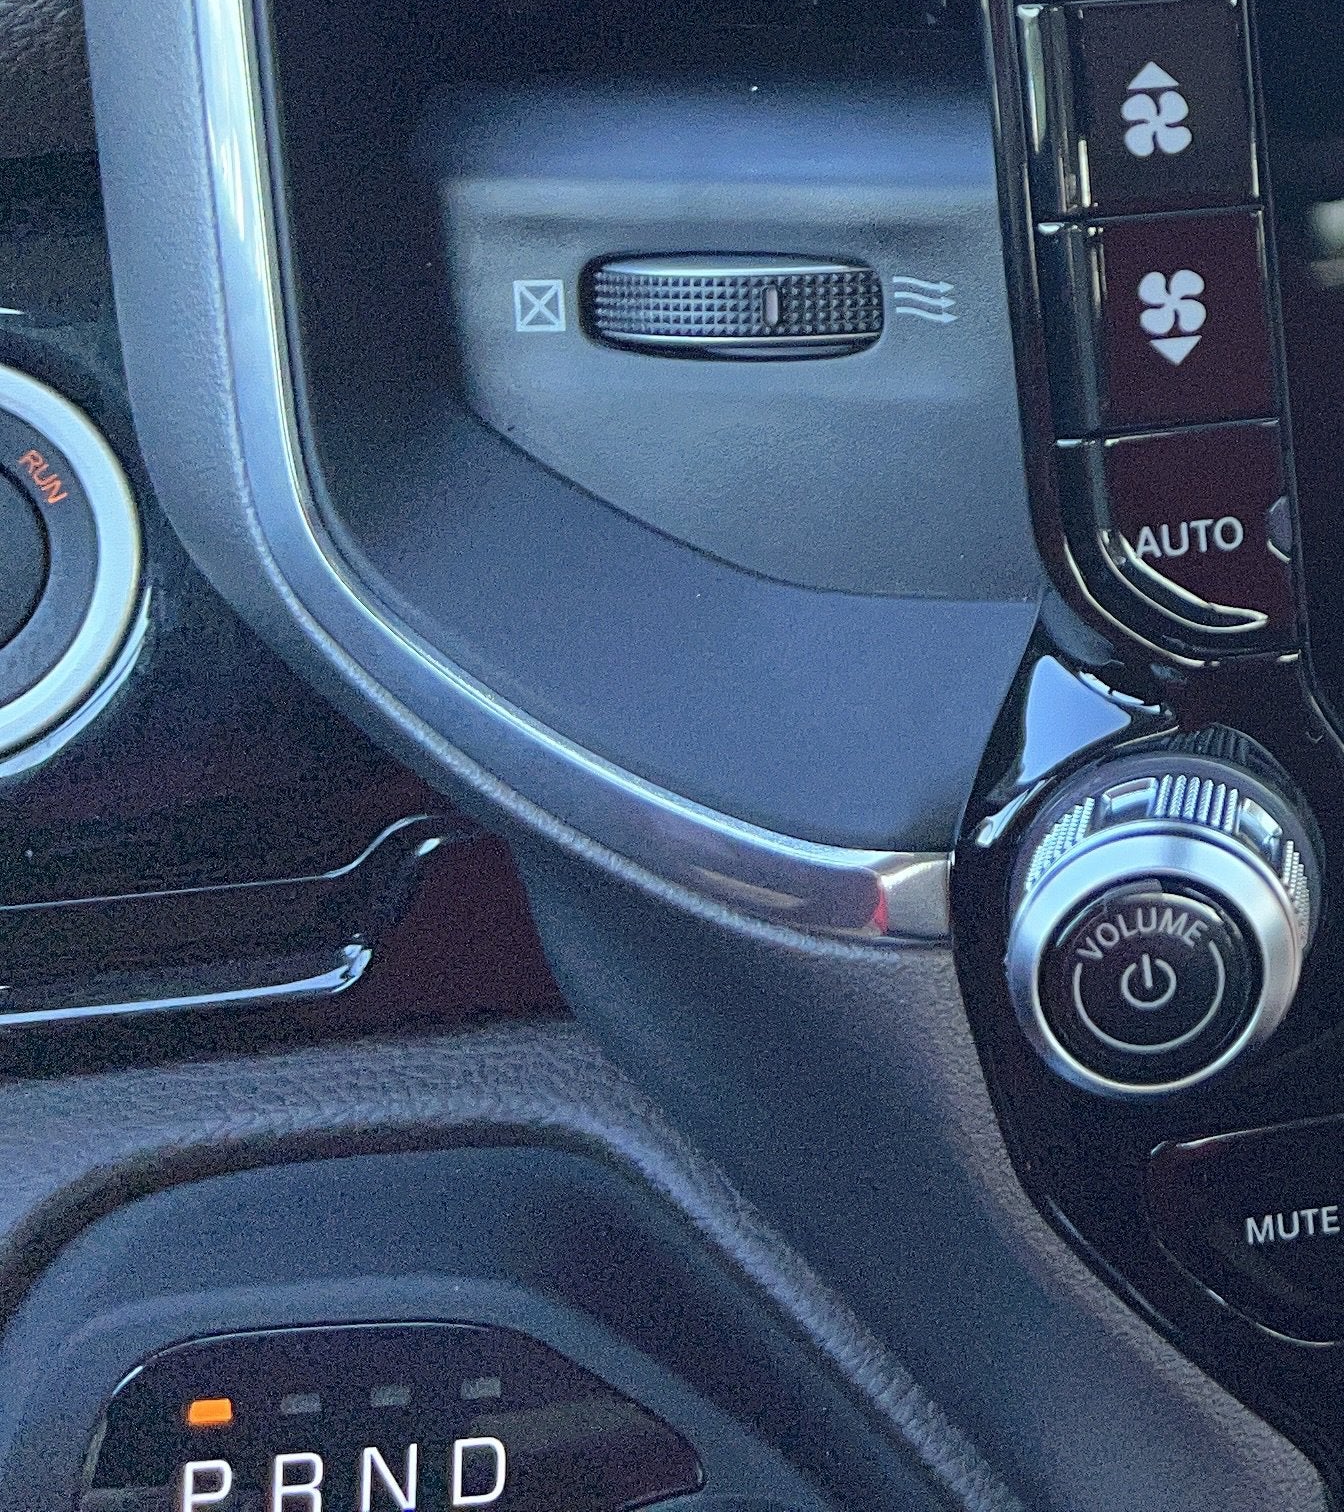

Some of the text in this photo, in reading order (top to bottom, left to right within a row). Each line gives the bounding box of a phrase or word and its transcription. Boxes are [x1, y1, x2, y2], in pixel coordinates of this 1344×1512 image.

[18, 449, 69, 505] RUN
[1135, 516, 1245, 559] AUTO
[1076, 906, 1209, 962] VOLUME
[1246, 1205, 1341, 1246] MUTE
